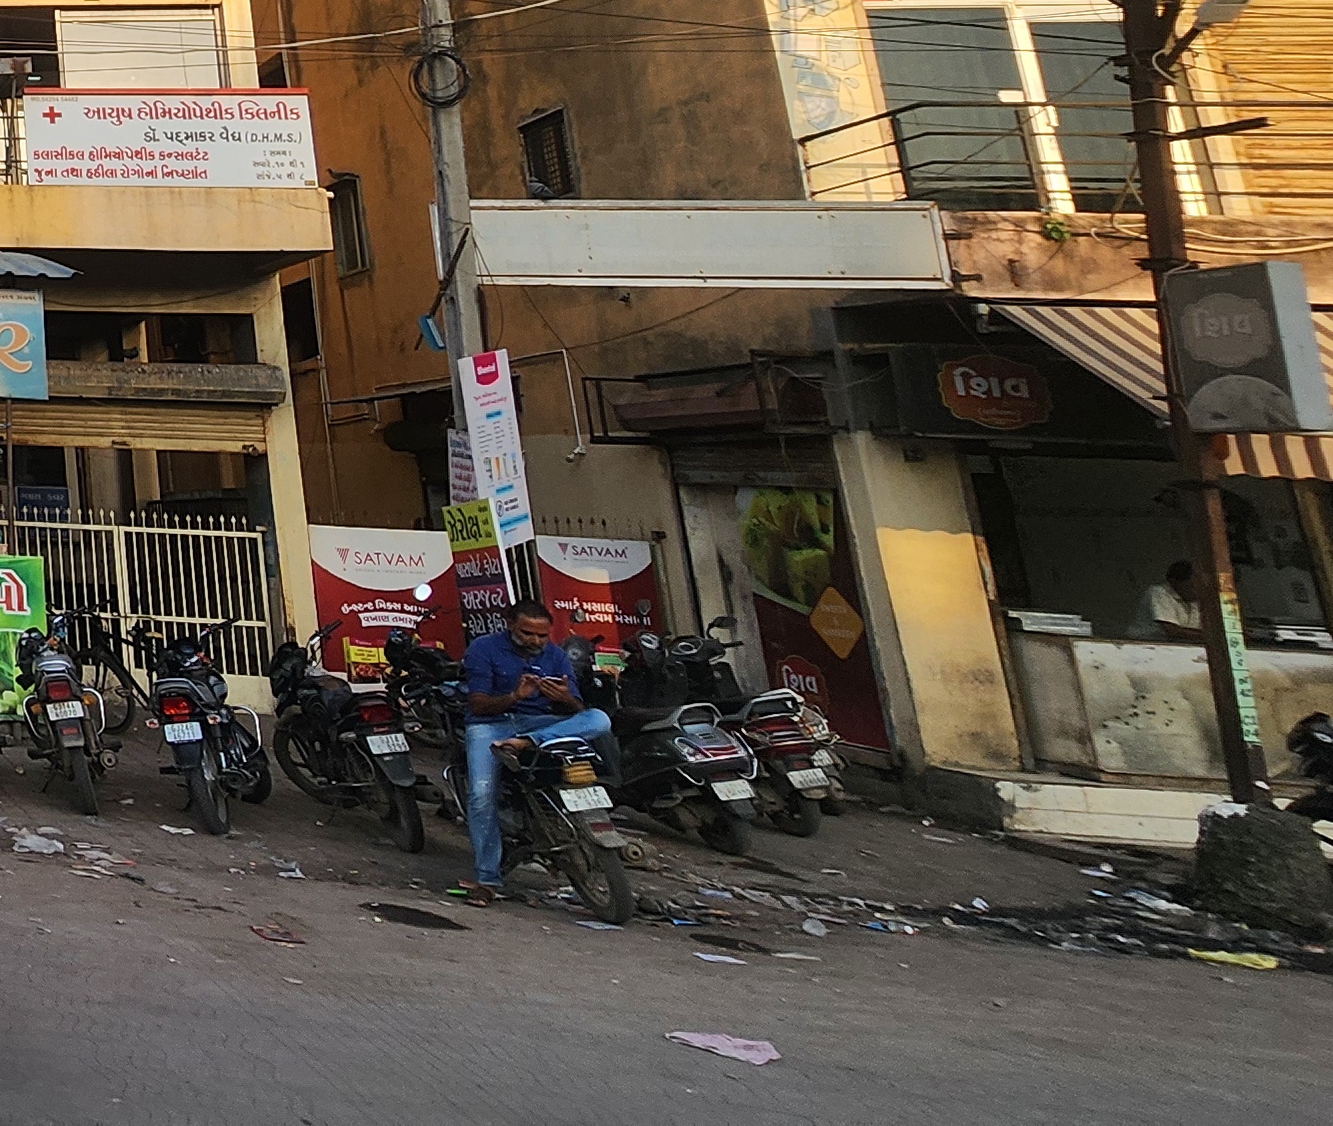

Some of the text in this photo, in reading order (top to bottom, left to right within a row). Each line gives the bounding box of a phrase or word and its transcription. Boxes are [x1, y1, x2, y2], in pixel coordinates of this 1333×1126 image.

[83, 100, 235, 125] આયુષ હોમિયોપેથીક
[245, 131, 303, 144] (D.H.M.S.)
[33, 146, 209, 162] કલાસીકલ હોમિયોપેથીક કન્સલટંટ
[33, 167, 58, 183] જુના
[60, 166, 83, 179] તથા
[86, 164, 118, 179] હઠીલા
[1192, 310, 1253, 337] શિવ
[952, 366, 1031, 400] શિવ
[354, 551, 425, 568] SATVAM
[572, 545, 628, 559] SATVAM
[461, 587, 507, 611] અરજન્ટ
[781, 664, 819, 694] શિવ
